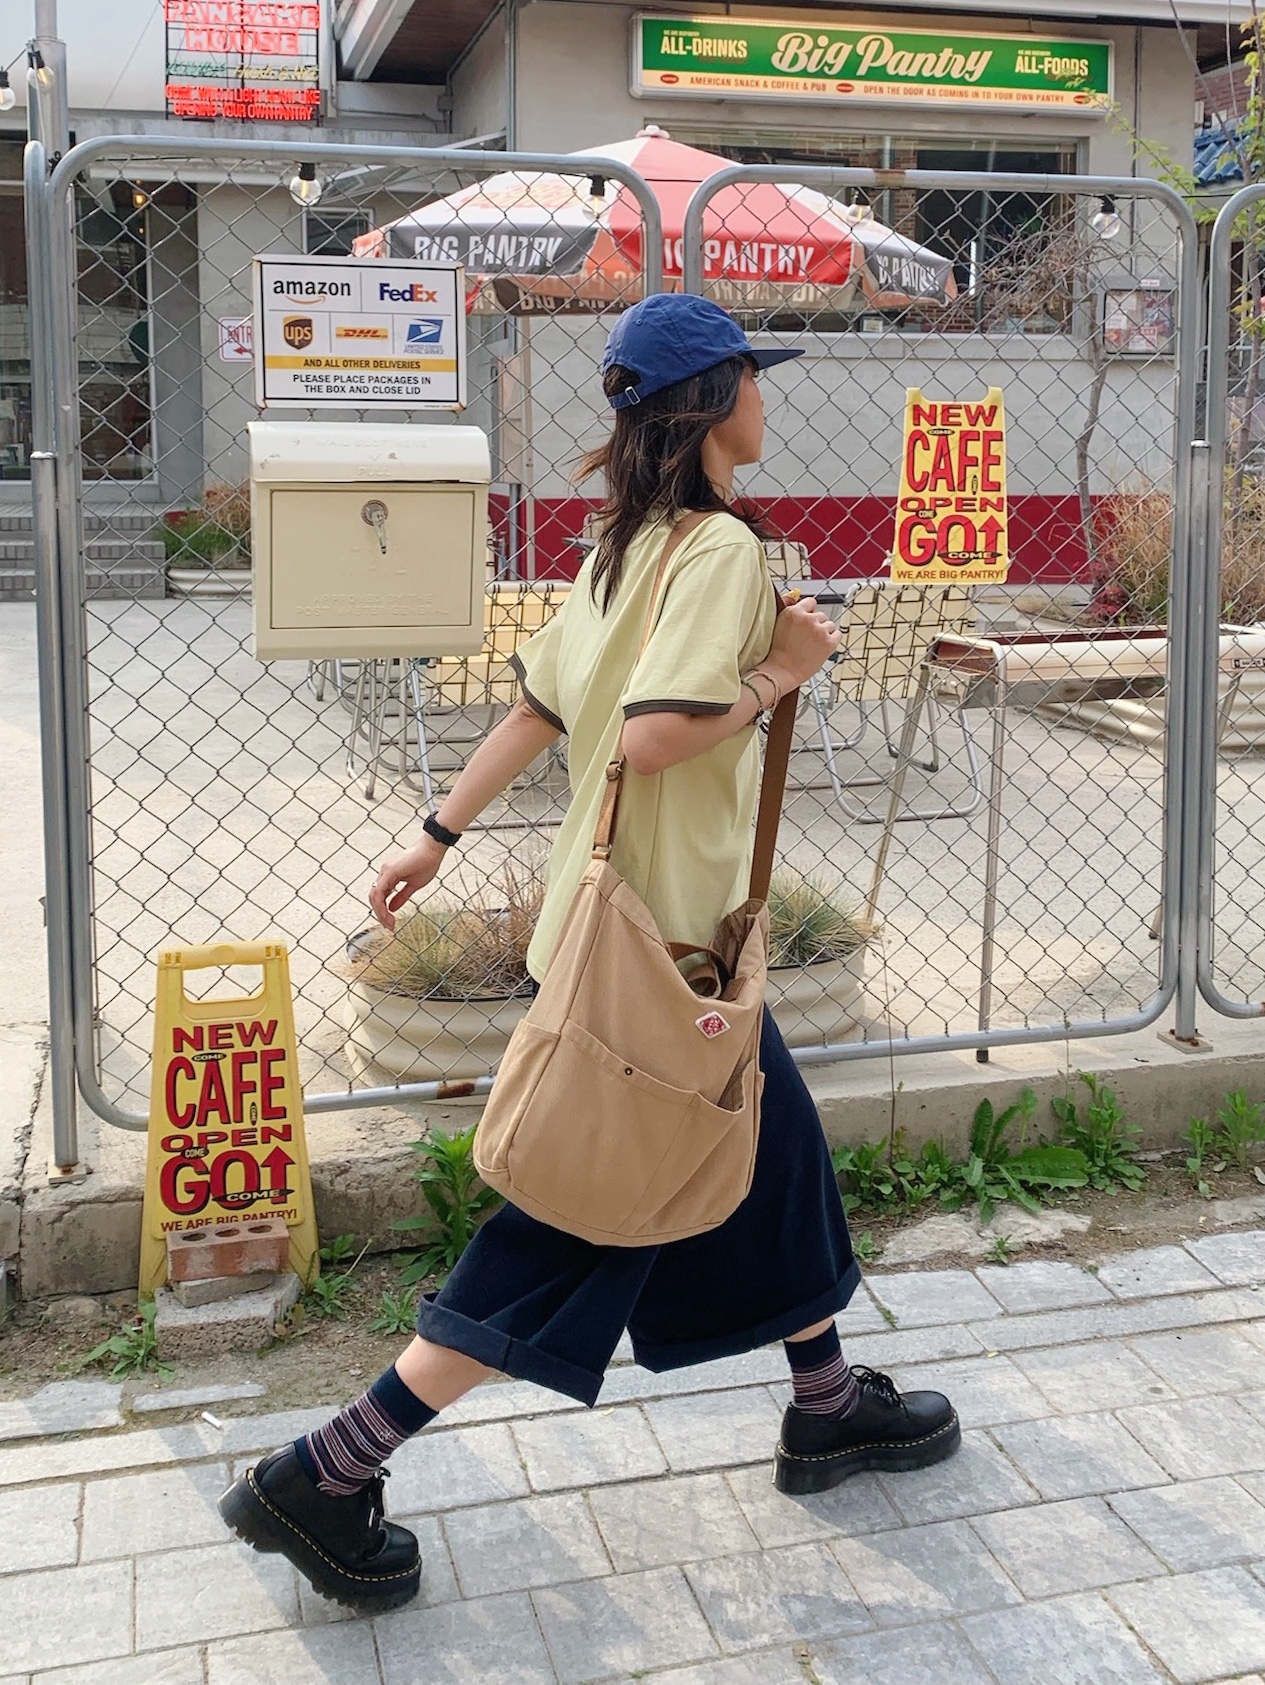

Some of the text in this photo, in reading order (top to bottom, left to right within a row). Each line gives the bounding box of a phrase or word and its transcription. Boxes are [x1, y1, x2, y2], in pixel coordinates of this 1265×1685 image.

[165, 1, 320, 28] PANCAKE
[185, 25, 299, 54] HOUSE
[661, 36, 748, 58] ALL-DRINKS
[771, 32, 993, 82] Big Pantry
[1015, 55, 1089, 76] ALL-FOODS
[690, 77, 731, 86] AMERICAN
[734, 79, 760, 88] SNACK
[763, 80, 769, 88] &
[771, 81, 799, 90] COFFEE
[803, 82, 809, 90] &
[811, 82, 827, 91] PUB
[863, 85, 884, 94] OPEN
[887, 86, 900, 95] THE
[903, 87, 924, 96] DOOR
[926, 88, 936, 96] AS
[938, 89, 969, 98] COMING
[982, 91, 991, 99] TO
[994, 92, 1013, 100] YOUR
[1016, 93, 1033, 101] OWN
[1036, 94, 1065, 103] PANTRY
[221, 102, 246, 118] YOUR
[274, 104, 313, 120] PANTRY
[468, 235, 563, 267] PANTRY
[703, 240, 814, 276] PANTRY
[273, 280, 438, 303] amazon FedEx
[284, 326, 381, 347] ups DHL
[303, 359, 421, 369] AND ALL OTHER DELIVERIES
[293, 375, 431, 385] PLEASE PLACE PACKAGES IN
[304, 385, 421, 395] THE BOX AND CLOSE LID
[912, 404, 998, 427] NEW
[906, 429, 1004, 492] CAFE
[900, 497, 1004, 512] OPEN
[898, 514, 977, 567] GO
[897, 571, 914, 579] WE
[915, 571, 937, 579] ARE
[940, 570, 957, 579] BIG
[172, 1020, 278, 1053] NEW
[193, 1053, 225, 1061] COME
[165, 1048, 287, 1129] CAFE
[161, 1124, 292, 1152] OPEN
[184, 1148, 206, 1158] COME
[160, 1149, 261, 1215] GO
[226, 1190, 280, 1201] COME
[161, 1221, 183, 1232] WE
[186, 1217, 213, 1230] ARE
